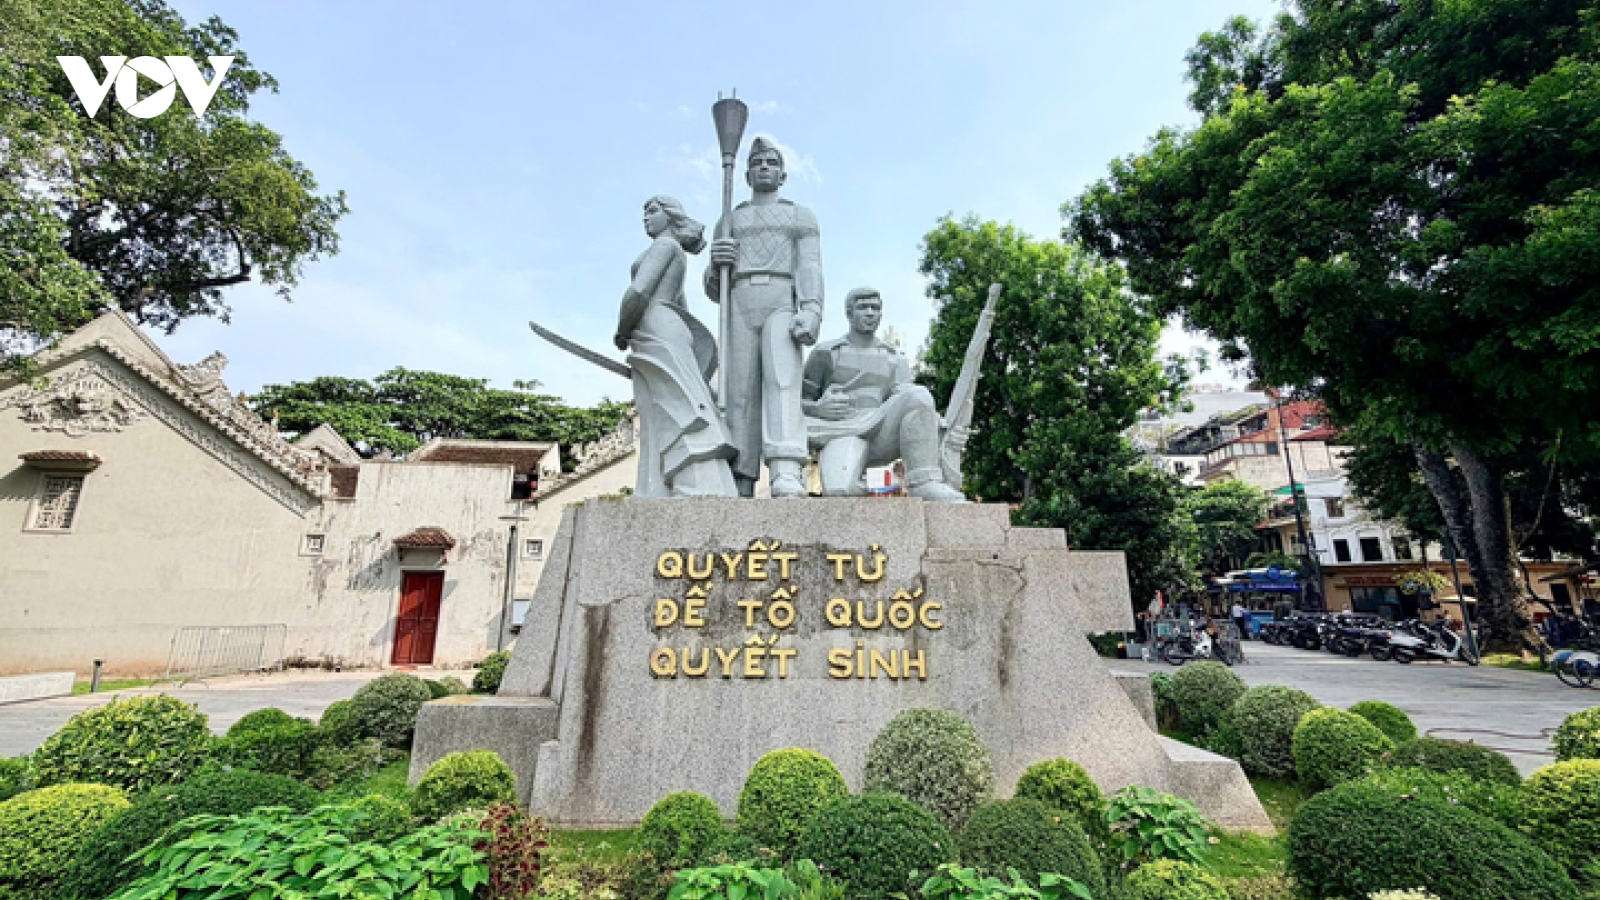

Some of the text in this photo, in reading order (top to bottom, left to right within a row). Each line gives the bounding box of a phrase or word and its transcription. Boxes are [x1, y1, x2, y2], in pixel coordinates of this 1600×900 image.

[657, 540, 799, 579] QUYẾT
[825, 587, 944, 629] QUỐC
[650, 633, 798, 677] QUYẾT
